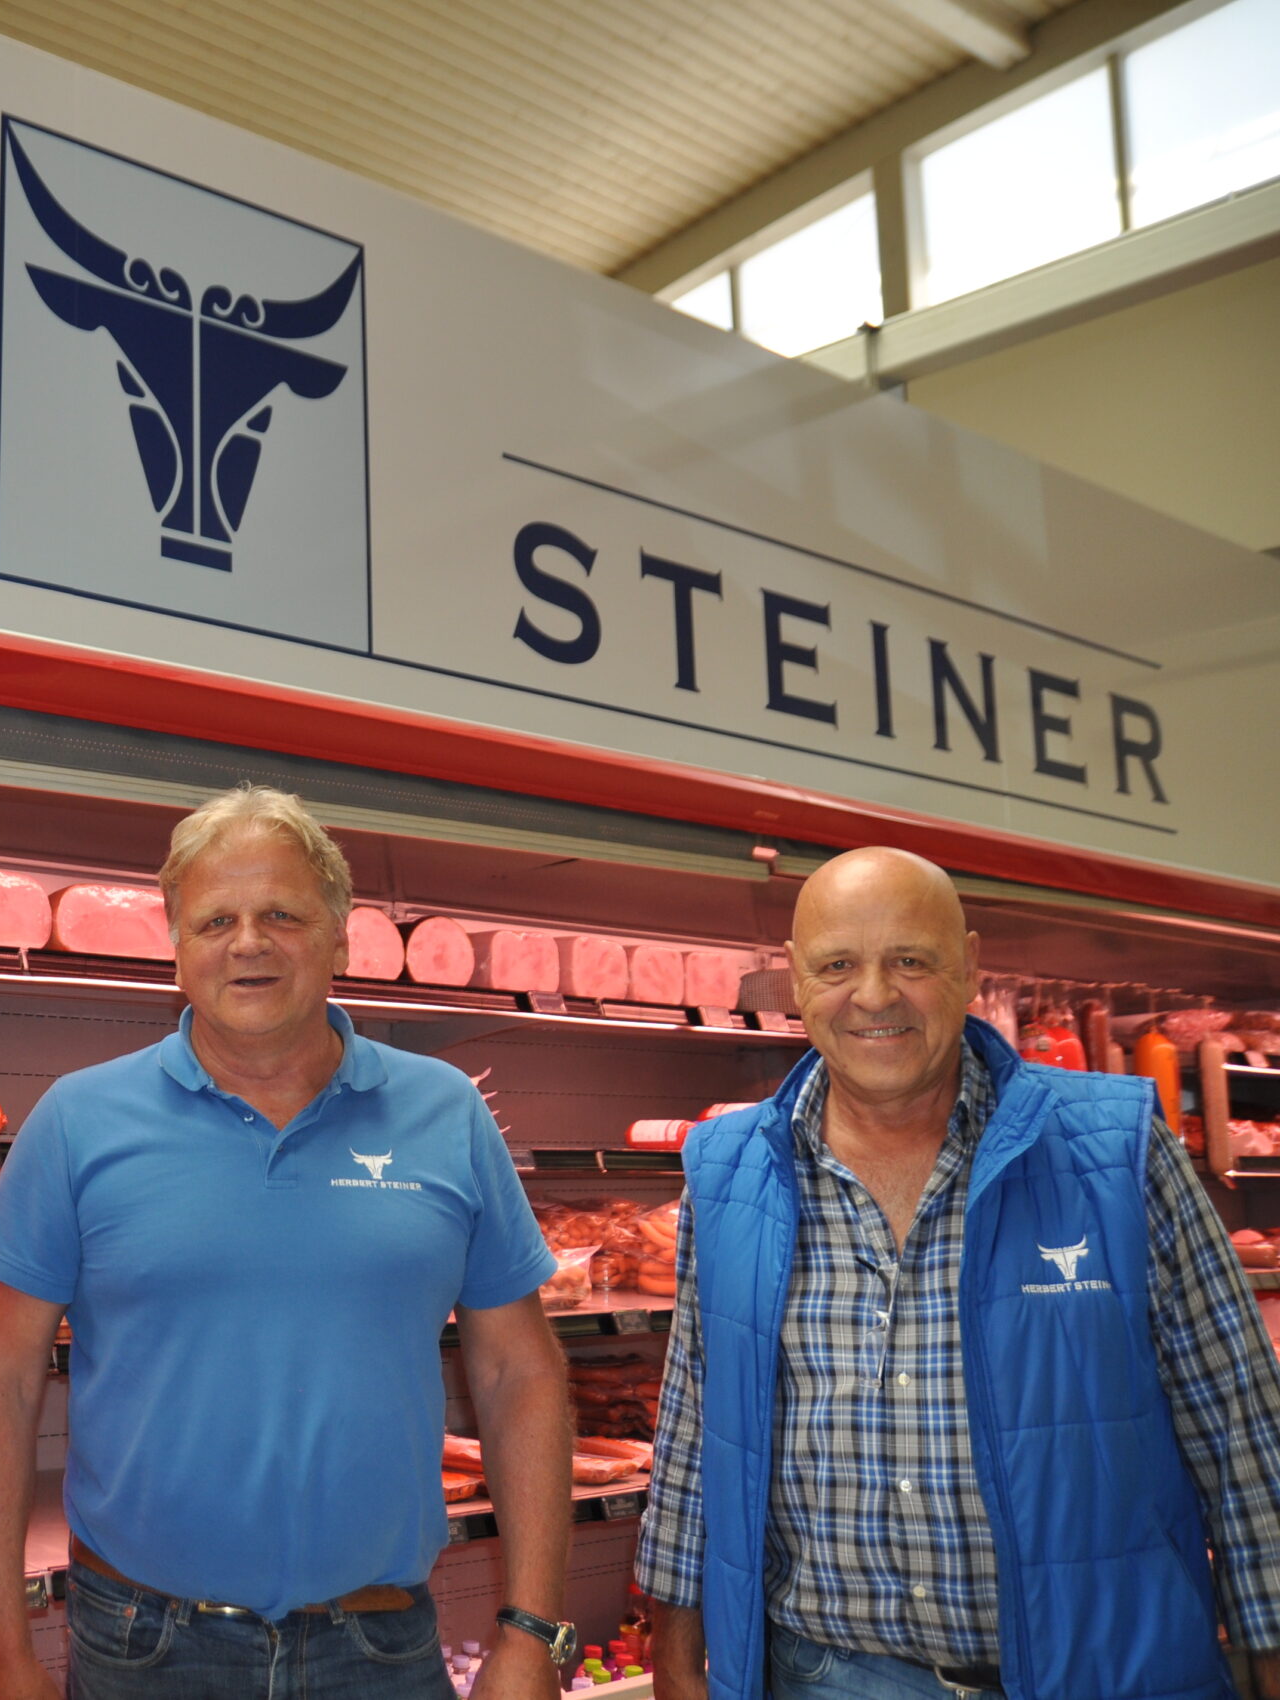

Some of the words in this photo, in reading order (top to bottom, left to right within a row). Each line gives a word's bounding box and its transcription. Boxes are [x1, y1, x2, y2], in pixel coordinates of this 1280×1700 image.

[512, 521, 1169, 804] STEINER
[330, 1179, 378, 1189] HERBERT
[380, 1181, 422, 1191] STEINER
[1021, 1282, 1073, 1294] HERBERT
[1073, 1280, 1112, 1291] STEIN
